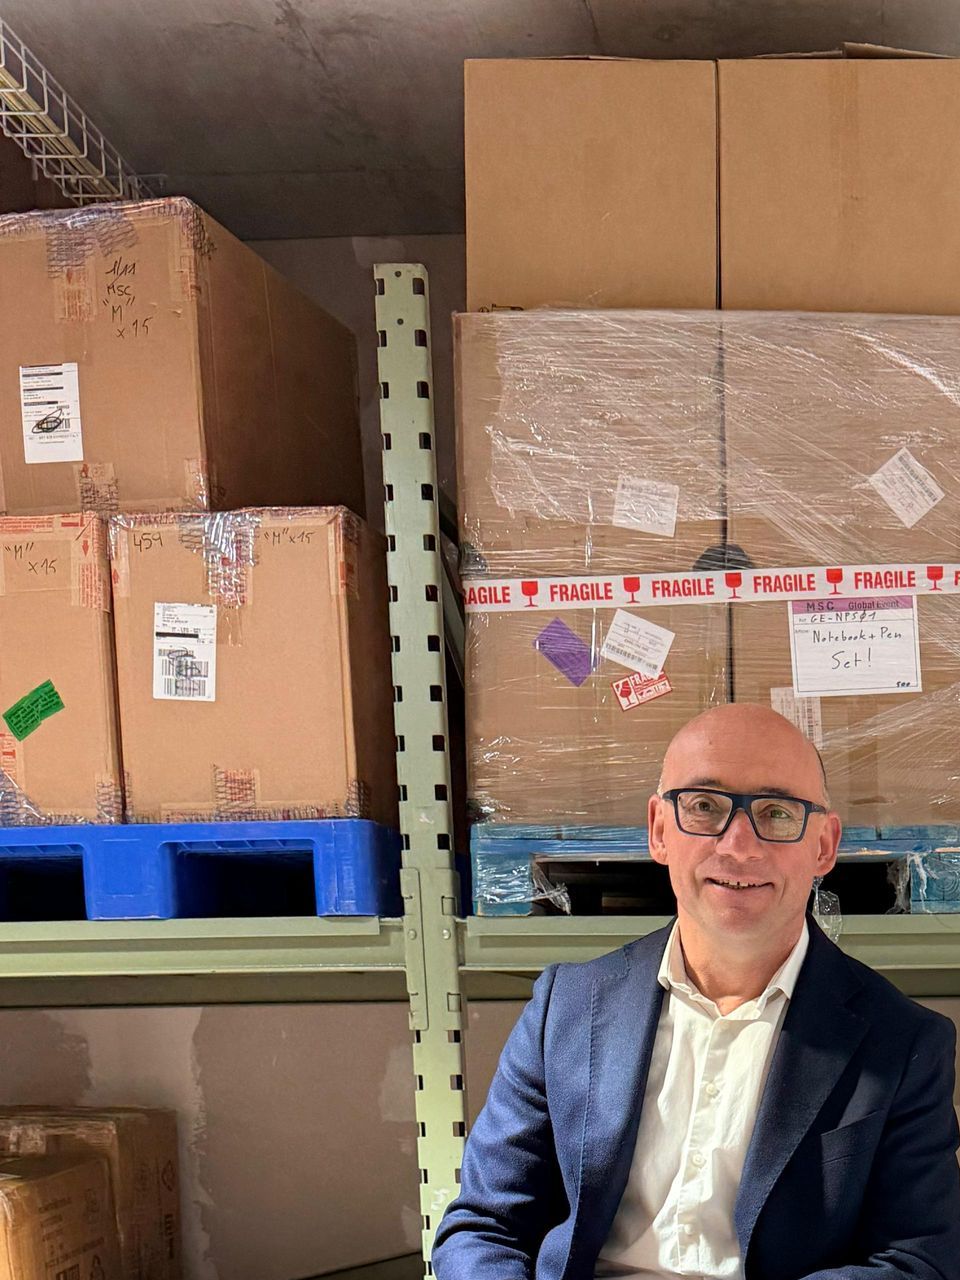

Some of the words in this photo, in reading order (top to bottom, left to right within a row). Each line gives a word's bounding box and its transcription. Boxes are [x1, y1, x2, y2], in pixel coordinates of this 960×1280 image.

[133, 531, 163, 552] 459
[550, 582, 613, 602] FRAGILE
[652, 578, 715, 598] FRAGILE
[753, 573, 816, 593] FRAGILE
[854, 570, 916, 590] FRAGILE
[807, 601, 835, 612] MSC
[848, 600, 875, 612] Global
[876, 599, 900, 609] Event
[813, 630, 866, 643] Notebook
[881, 627, 902, 639] Pen
